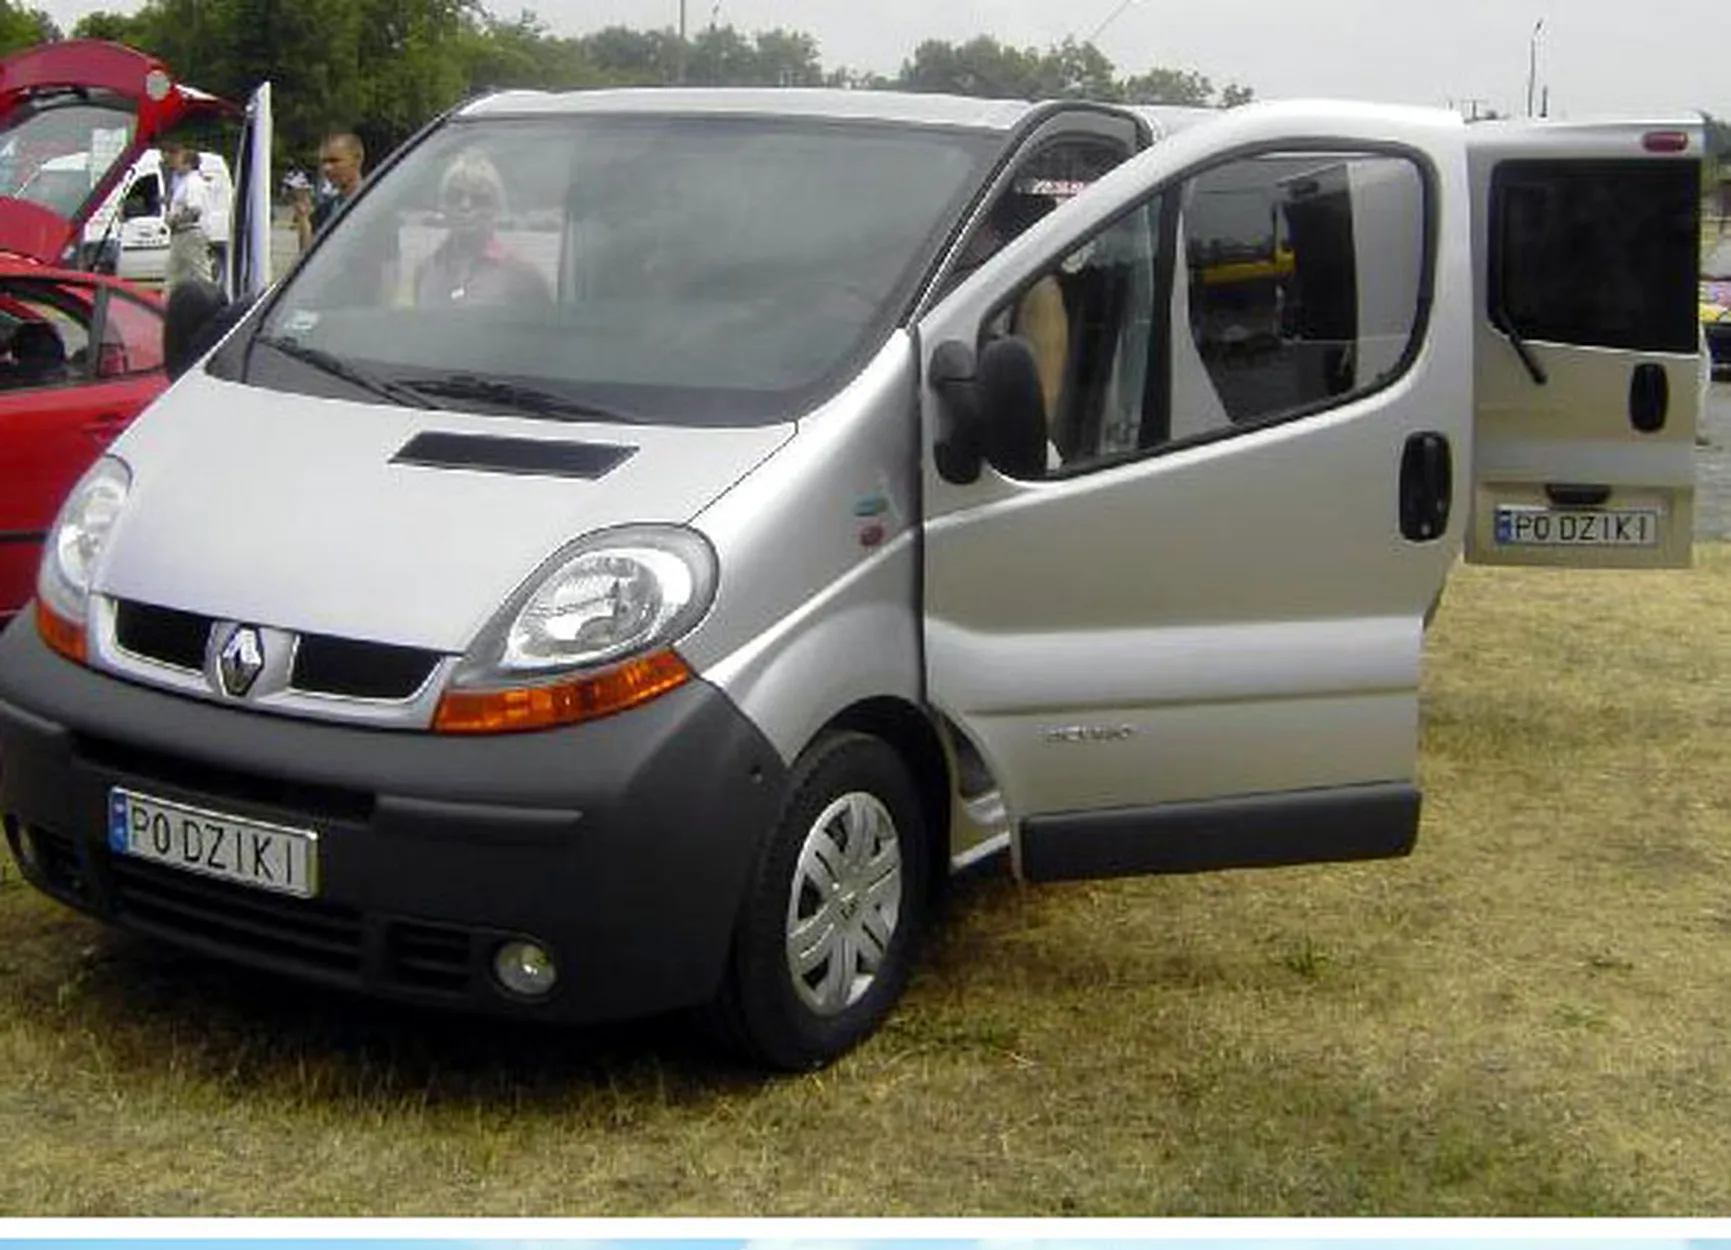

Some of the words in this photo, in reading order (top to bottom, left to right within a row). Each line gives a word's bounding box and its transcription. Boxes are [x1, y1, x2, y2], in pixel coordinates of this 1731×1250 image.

[1516, 515, 1550, 541] PO
[1560, 515, 1647, 541] DZIKI
[131, 804, 171, 856] PO
[182, 818, 292, 886] DZIKI
